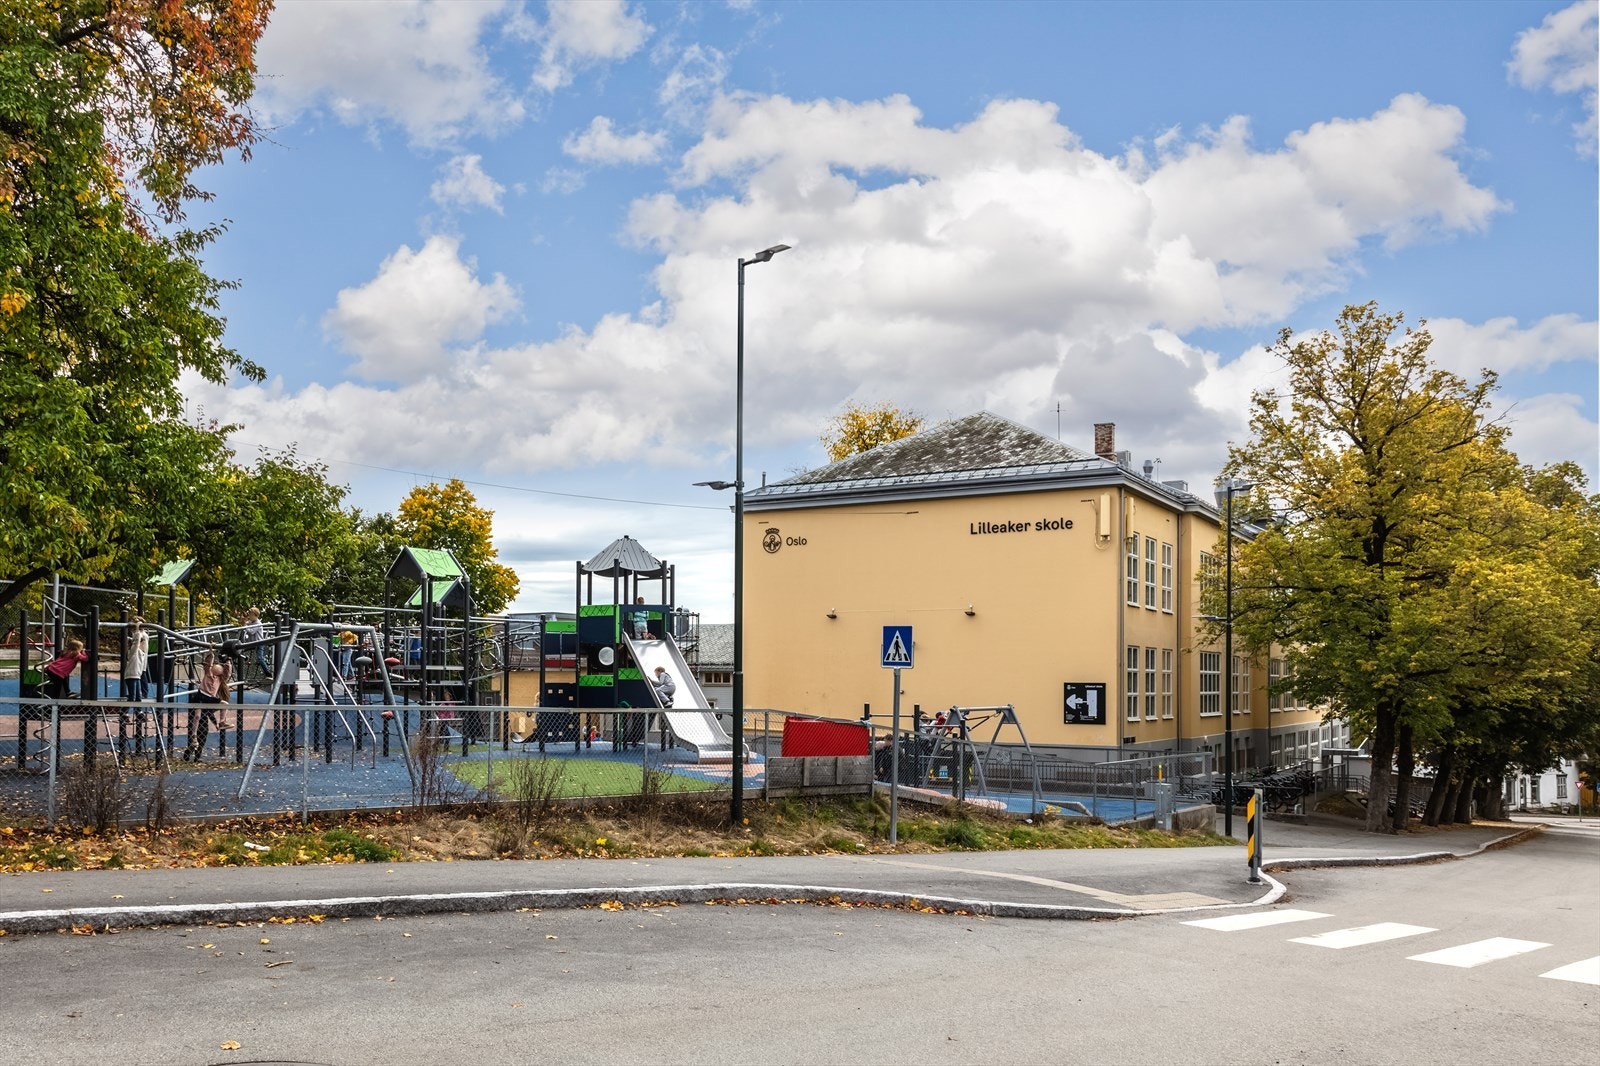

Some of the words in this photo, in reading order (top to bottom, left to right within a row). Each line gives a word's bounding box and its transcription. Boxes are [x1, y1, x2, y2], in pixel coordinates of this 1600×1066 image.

[970, 520, 1031, 535] Lilleaker
[1035, 517, 1073, 531] skole
[786, 536, 808, 546] Oslo
